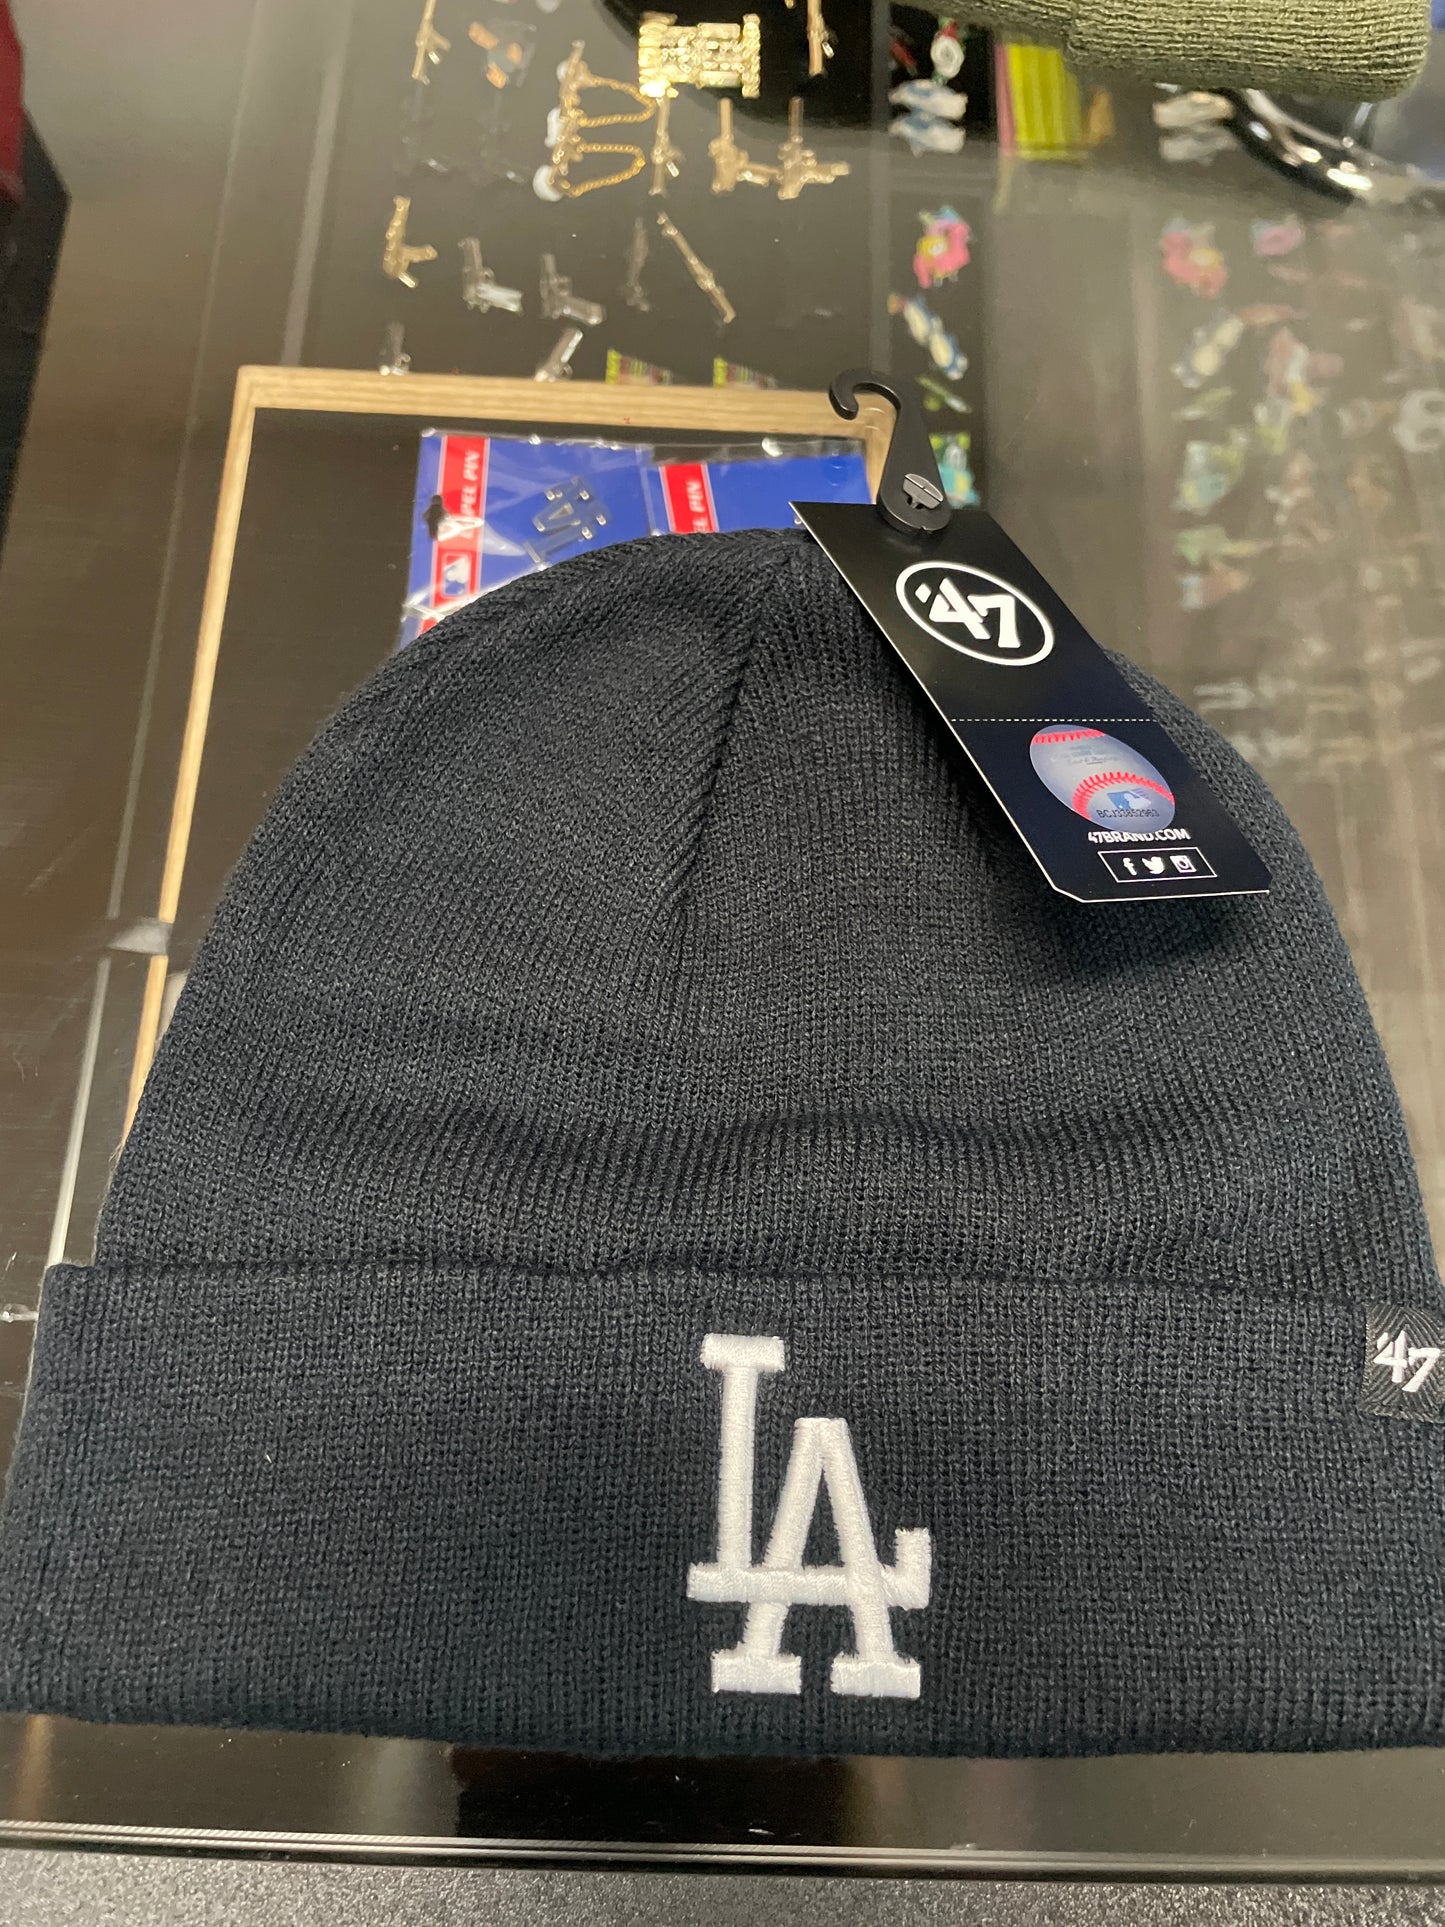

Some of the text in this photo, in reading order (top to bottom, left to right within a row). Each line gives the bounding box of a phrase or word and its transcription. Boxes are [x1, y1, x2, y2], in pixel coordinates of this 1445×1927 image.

[463, 450, 481, 481] PIN
[686, 480, 706, 512] PIN
[1087, 828, 1192, 844] 47BRAND.COM
[687, 1333, 932, 1698] LA
